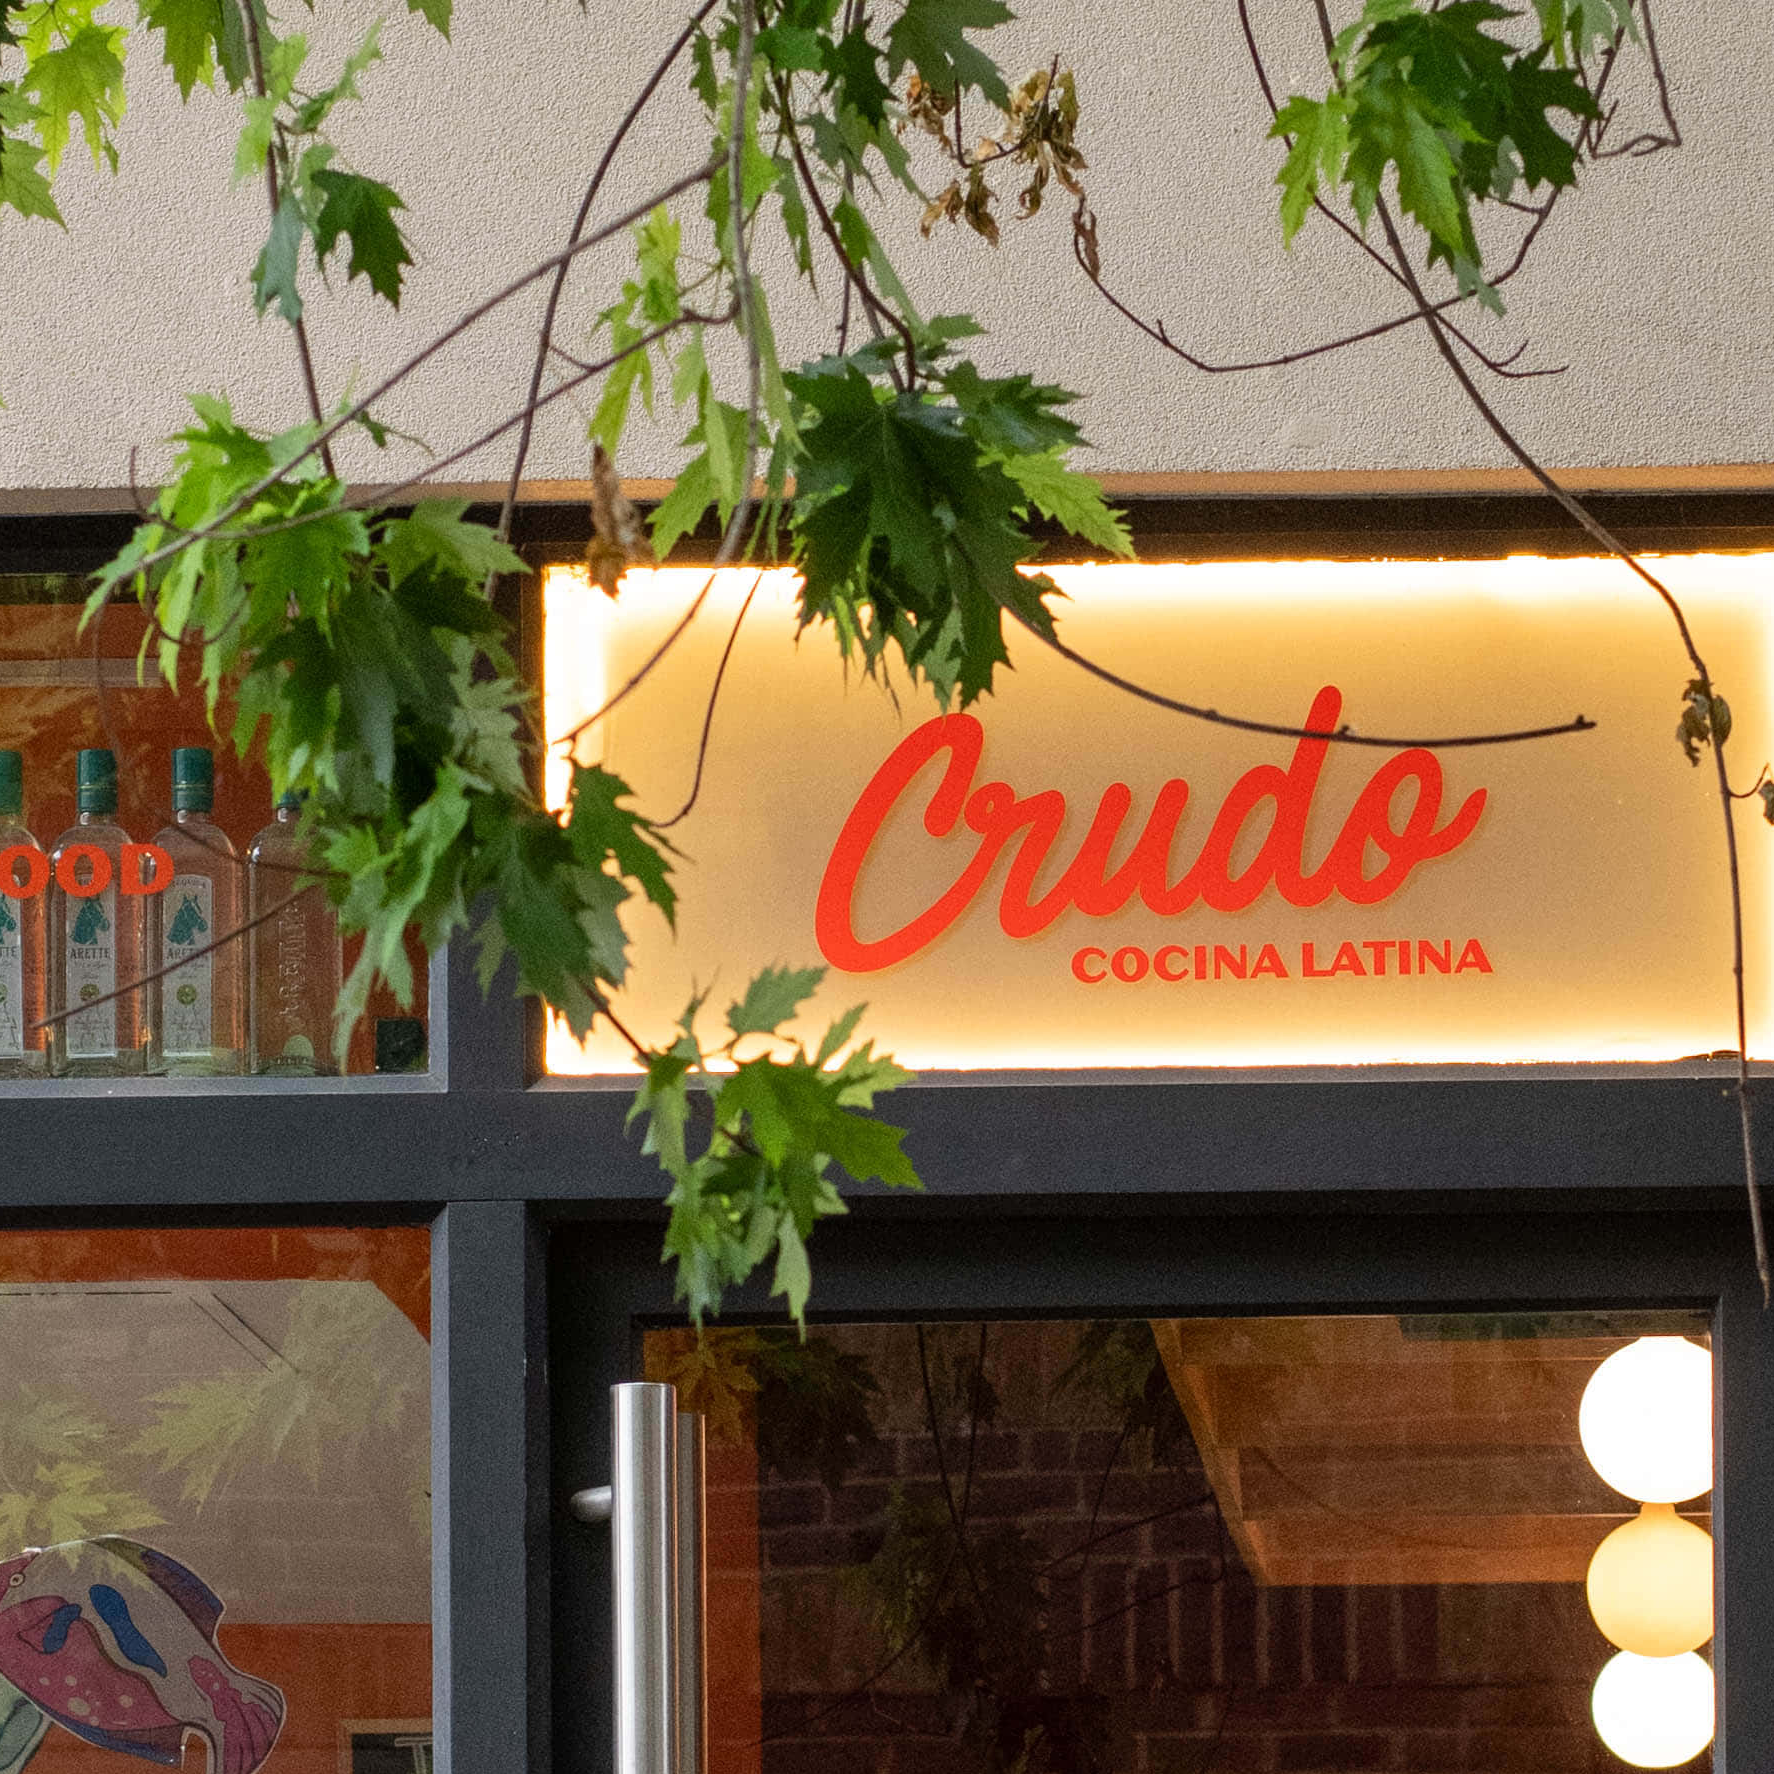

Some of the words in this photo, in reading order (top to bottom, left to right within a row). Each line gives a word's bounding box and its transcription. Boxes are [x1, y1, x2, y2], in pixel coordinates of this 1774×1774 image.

[814, 684, 1488, 976] Crudo
[1071, 943, 1289, 984] COCINA
[1301, 938, 1493, 978] LATINA
